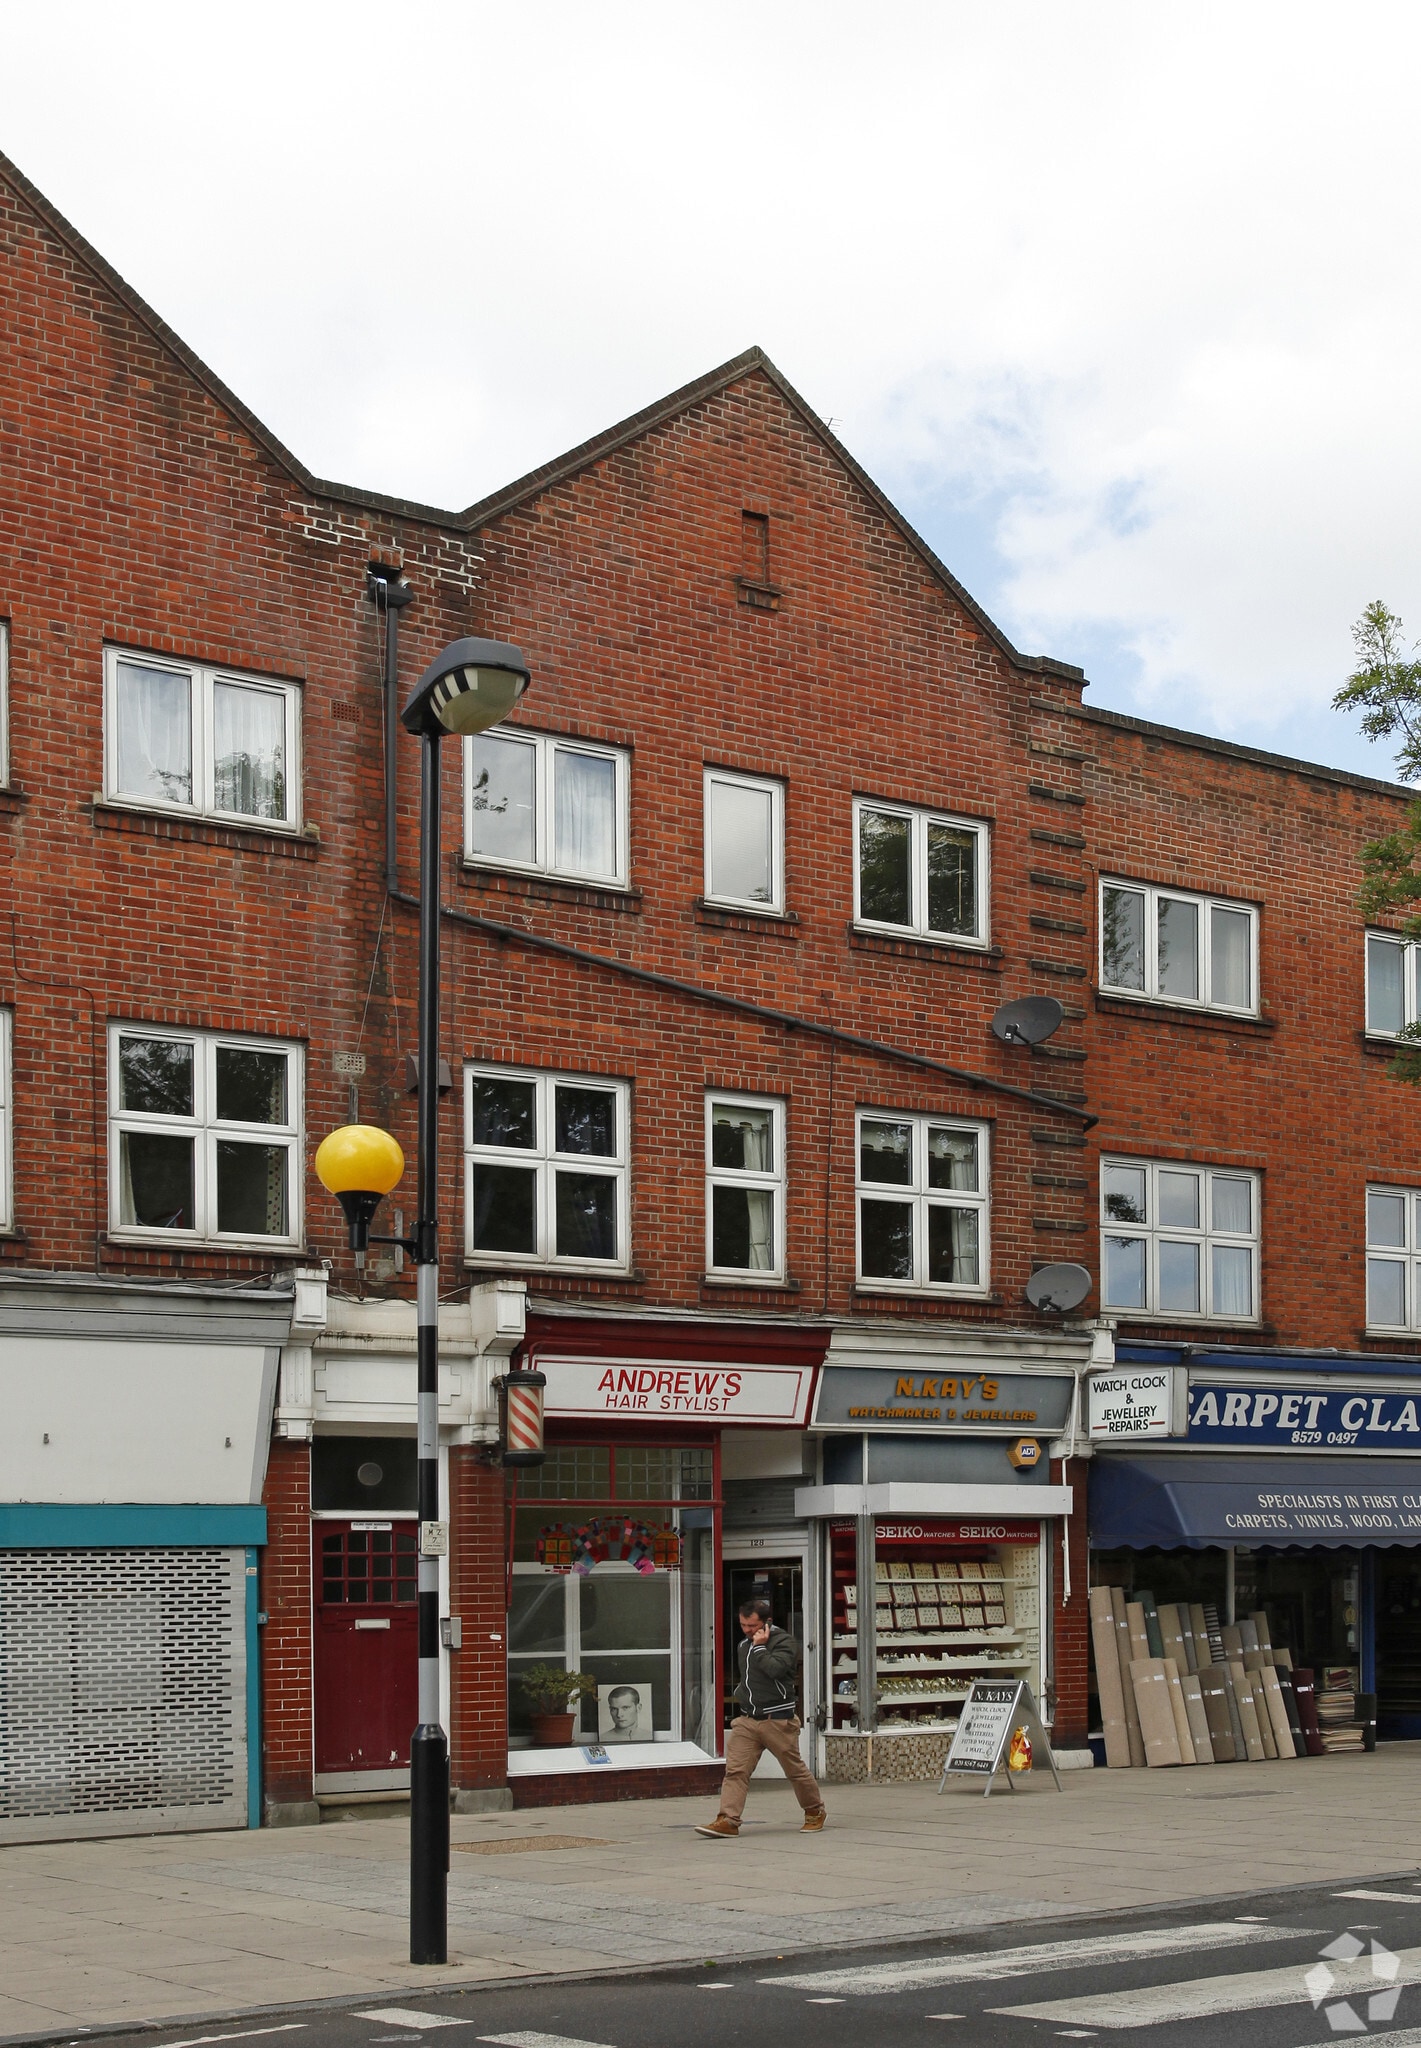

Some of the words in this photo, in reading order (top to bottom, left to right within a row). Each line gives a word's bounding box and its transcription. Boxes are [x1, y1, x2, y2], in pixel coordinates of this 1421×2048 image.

[597, 1368, 742, 1397] ANDREW'S
[895, 1374, 999, 1400] N.KAY'S
[1093, 1379, 1127, 1393] WATCH
[1131, 1375, 1166, 1390] CLOCK
[605, 1394, 649, 1409] HAIR
[660, 1394, 731, 1411] STYLIST
[1125, 1393, 1134, 1404] &
[849, 1406, 940, 1419] WATCHMAKER
[962, 1409, 1037, 1421] JEWELLERS
[1101, 1405, 1157, 1421] JEWELLERY
[1108, 1418, 1149, 1433] REPAIRS
[1291, 1430, 1322, 1444] 8579
[1326, 1431, 1359, 1444] 0497
[1021, 1447, 1035, 1456] ADT
[1258, 1494, 1342, 1509] SPECIALISTS
[1344, 1495, 1360, 1509] IN
[1362, 1495, 1399, 1509] FIRST
[1225, 1514, 1294, 1530] CARPETS,
[1294, 1514, 1349, 1529] VINYLS,
[1350, 1514, 1398, 1529] WOOD,
[875, 1526, 923, 1539] SEIKO
[959, 1526, 1006, 1539] SEIKO
[974, 1690, 984, 1701] N.
[986, 1690, 1013, 1702] KAYS
